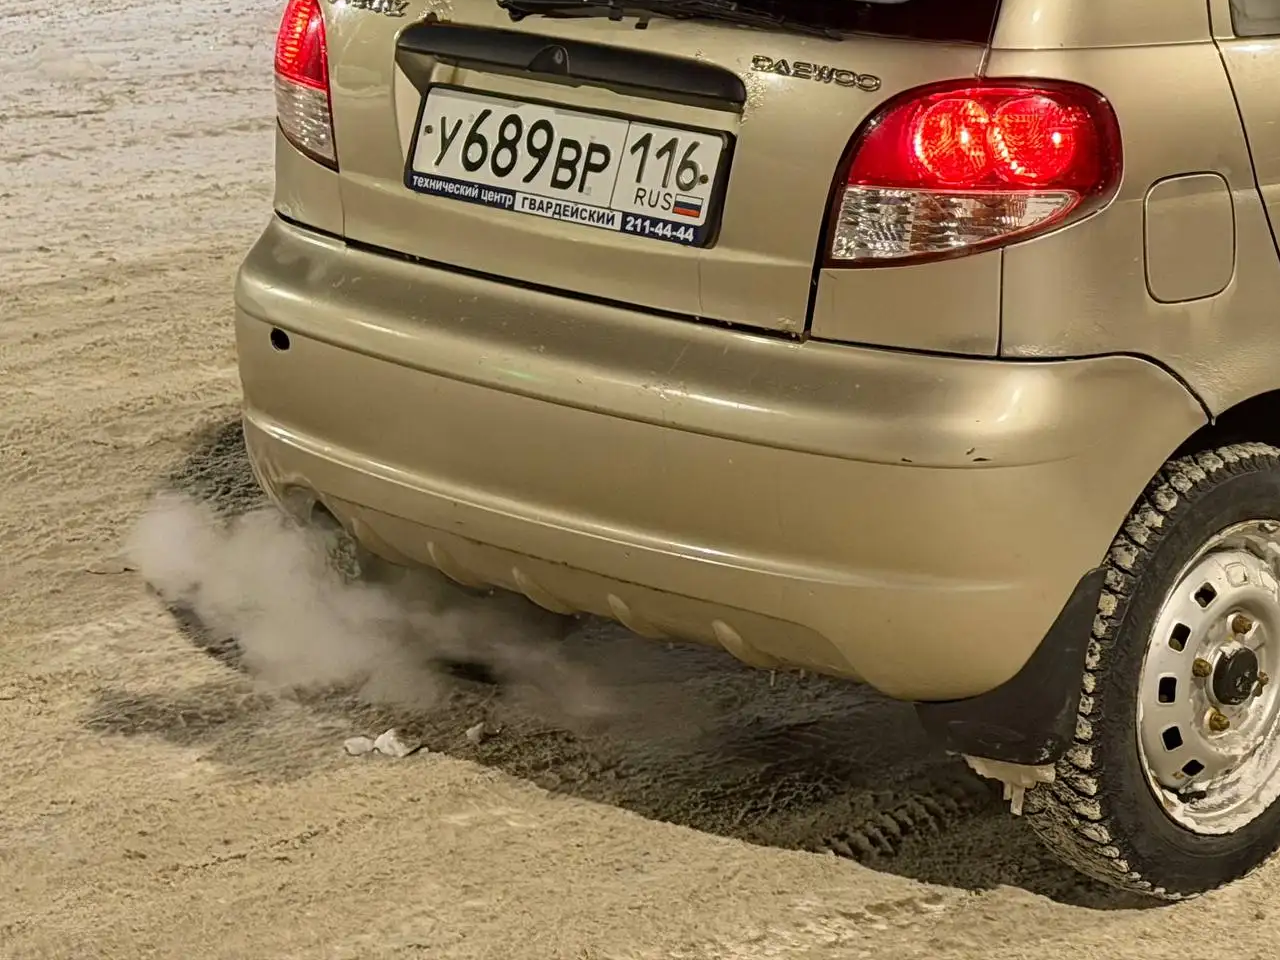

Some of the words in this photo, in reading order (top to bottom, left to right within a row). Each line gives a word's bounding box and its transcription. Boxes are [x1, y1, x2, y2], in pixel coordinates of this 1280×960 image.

[750, 54, 882, 92] DAEWOO
[434, 108, 612, 193] У689ВР
[629, 132, 700, 192] 116
[412, 175, 479, 199] технический
[481, 188, 514, 209] центр
[521, 196, 616, 227] ГВАРДЕЙСКИЙ
[625, 216, 695, 242] 211-44-44
[633, 187, 673, 211] RUS
